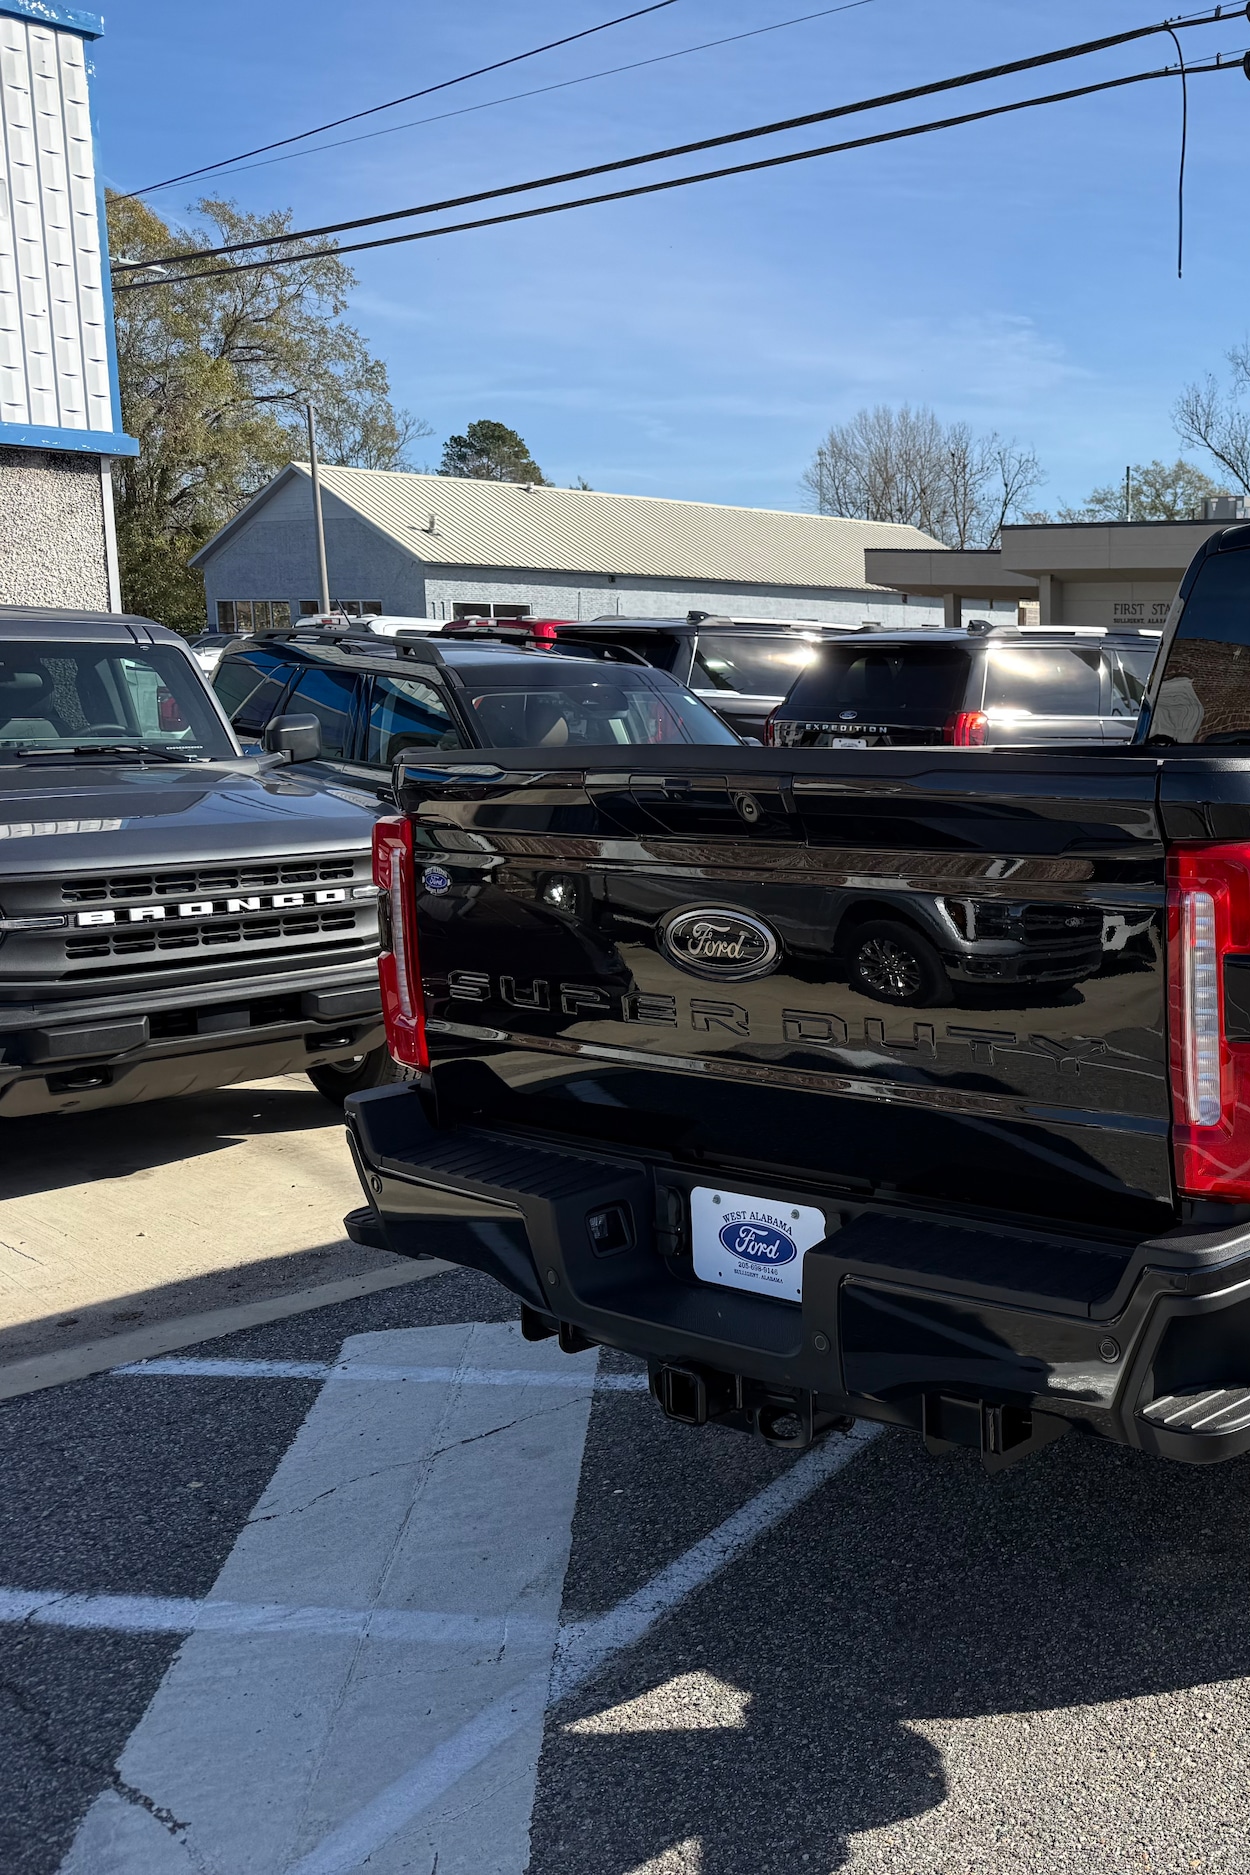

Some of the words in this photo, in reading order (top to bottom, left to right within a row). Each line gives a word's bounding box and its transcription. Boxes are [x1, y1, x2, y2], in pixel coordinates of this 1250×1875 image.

[1113, 603, 1145, 615] FIRST
[805, 723, 888, 734] EXPEDITION
[77, 888, 346, 926] BRONCO
[687, 921, 745, 959] Ford
[447, 970, 750, 1037] SUPER
[782, 1007, 1105, 1077] DUTY
[722, 1210, 747, 1224] WEST
[749, 1211, 793, 1237] ALABAMA
[734, 1225, 780, 1259] Ford
